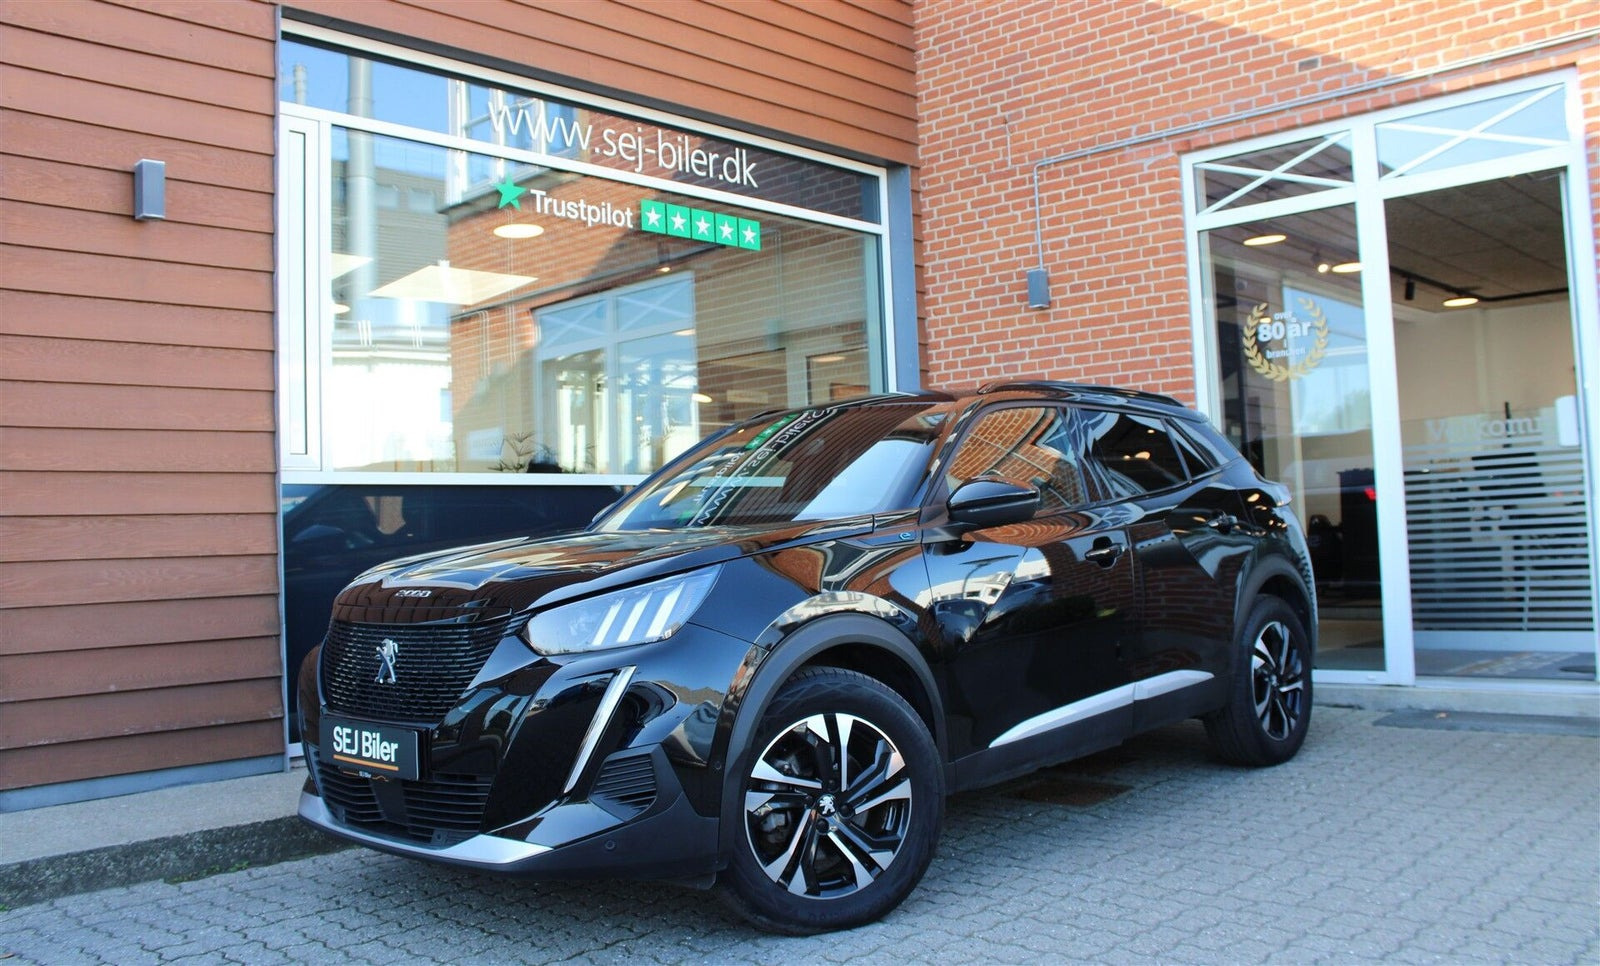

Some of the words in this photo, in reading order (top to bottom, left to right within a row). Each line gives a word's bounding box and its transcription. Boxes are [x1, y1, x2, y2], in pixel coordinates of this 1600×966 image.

[487, 100, 759, 189] www.sej-biler.dk
[529, 188, 634, 229] Trustpilot
[1257, 321, 1286, 343] 80
[1286, 317, 1312, 337] år
[332, 725, 359, 756] SEJ
[361, 730, 399, 763] Biler
